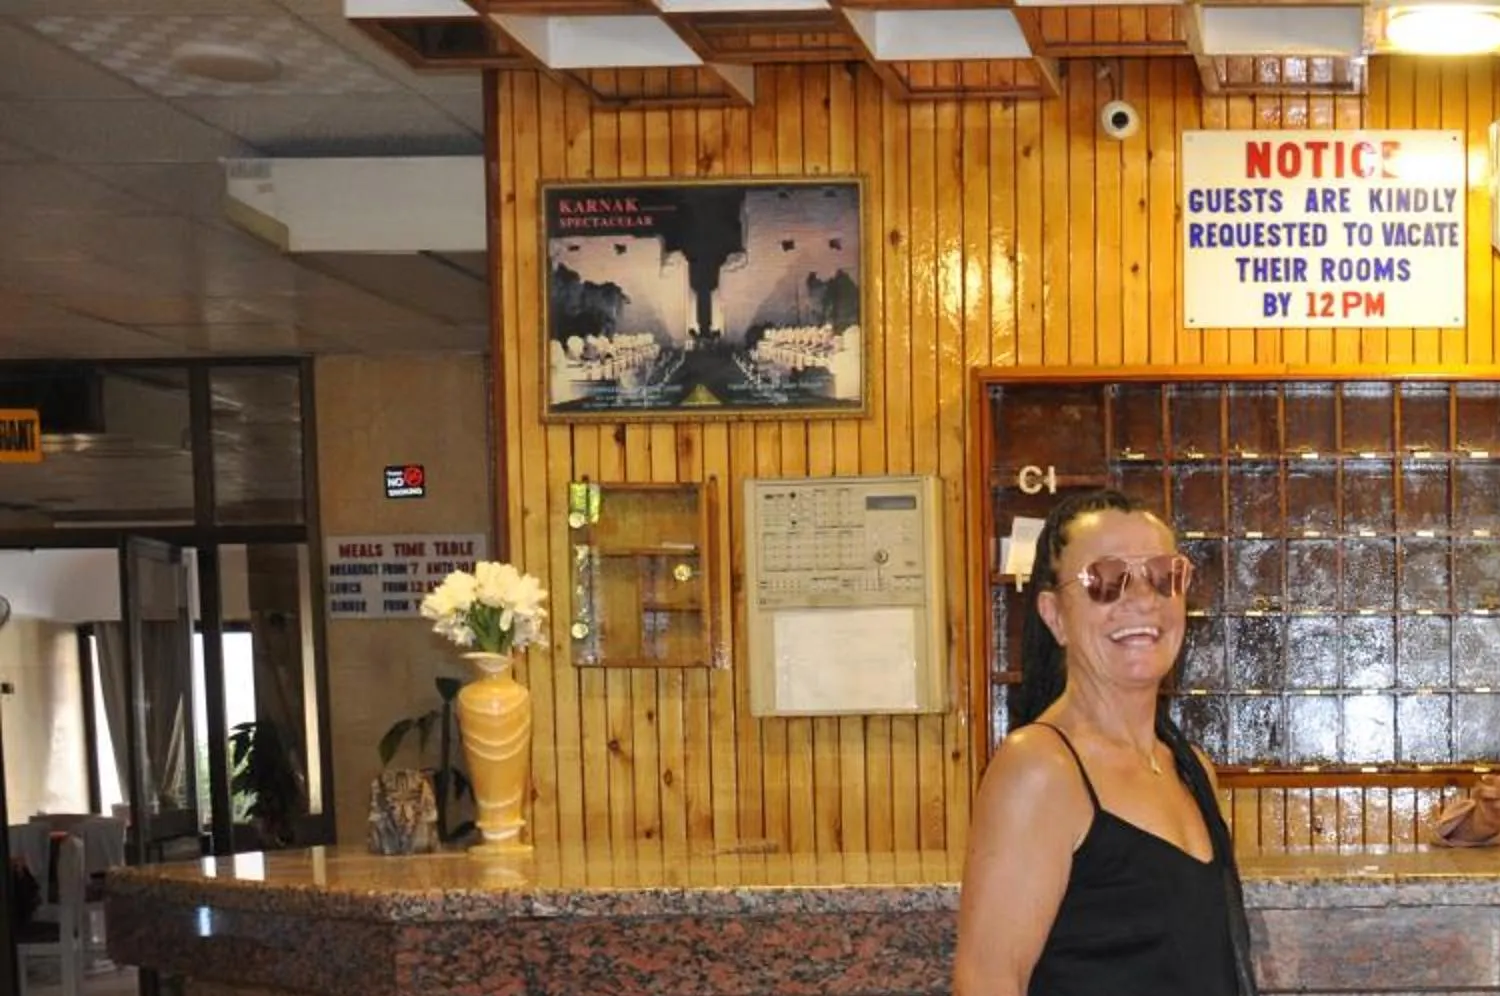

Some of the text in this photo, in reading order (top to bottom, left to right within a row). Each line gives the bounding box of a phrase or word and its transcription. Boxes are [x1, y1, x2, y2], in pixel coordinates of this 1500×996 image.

[1245, 140, 1401, 179] NOTICE
[559, 198, 638, 213] KARNAK
[1188, 187, 1458, 214] GUESTS ARE KINDLY
[559, 215, 654, 229] SPECTACULAR
[1188, 222, 1459, 248] REQUESTED TO VACATE
[1235, 257, 1412, 283] THEIR ROOMS
[1262, 291, 1292, 318] BY
[387, 477, 404, 487] NO
[338, 540, 474, 558] MEALS TIME TABLE
[410, 562, 419, 574] 7
[382, 580, 408, 593] FROM
